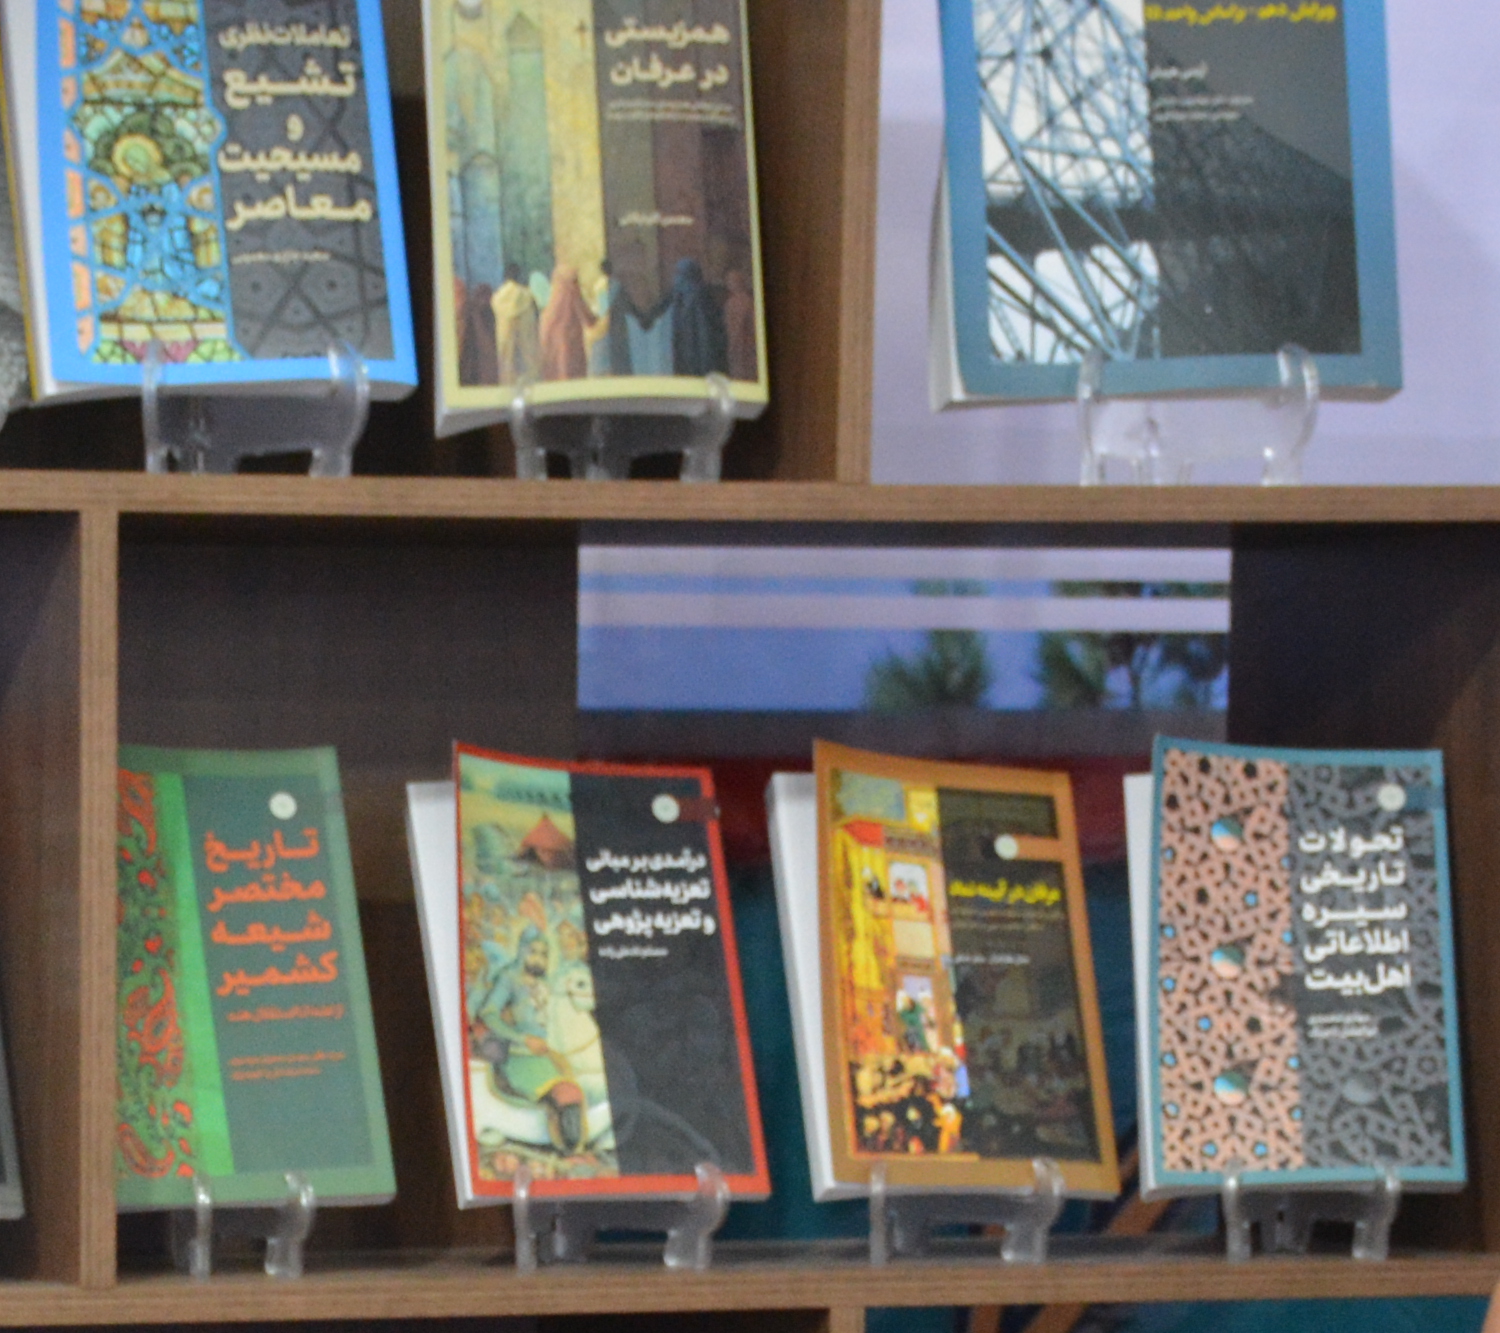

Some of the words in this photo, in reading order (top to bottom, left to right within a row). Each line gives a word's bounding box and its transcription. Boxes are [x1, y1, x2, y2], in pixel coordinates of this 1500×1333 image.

[219, 21, 269, 52] نظری
[270, 23, 351, 48] تعاملات
[604, 16, 731, 49] همزیستی
[222, 57, 356, 110] تشیع
[610, 53, 696, 88] عرفان
[699, 63, 730, 91] در
[287, 113, 305, 142] و
[218, 143, 362, 182] مسیحیت
[225, 183, 373, 231] معاصر
[204, 827, 319, 873] تاریخ
[1299, 825, 1404, 859] تحولات
[650, 847, 706, 872] درآمدی
[1300, 860, 1406, 893] تاریخی
[207, 871, 326, 913] مختصر
[211, 909, 333, 953] شیعه
[702, 915, 716, 936] و
[1302, 902, 1408, 928] سیره
[1303, 928, 1410, 962] اطلاعاتی
[215, 949, 339, 997] کشمیر
